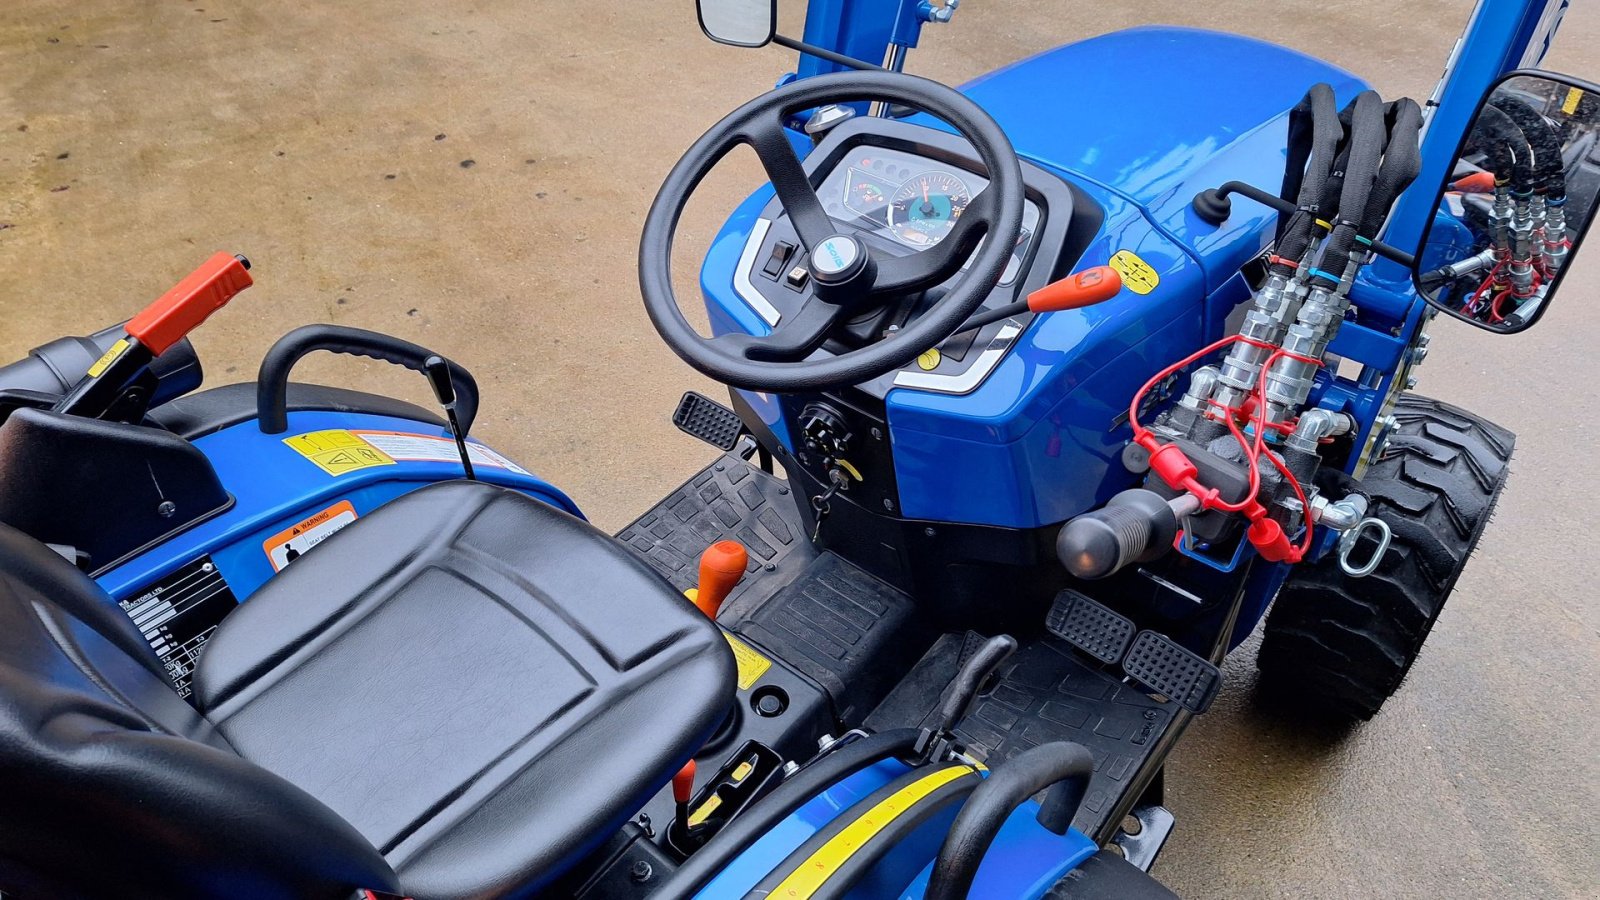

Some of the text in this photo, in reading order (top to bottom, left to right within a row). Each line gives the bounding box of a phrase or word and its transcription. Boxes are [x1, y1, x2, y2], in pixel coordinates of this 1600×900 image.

[301, 512, 329, 529] WARNING
[122, 593, 153, 611] TRACTORS
[815, 860, 825, 870] 8
